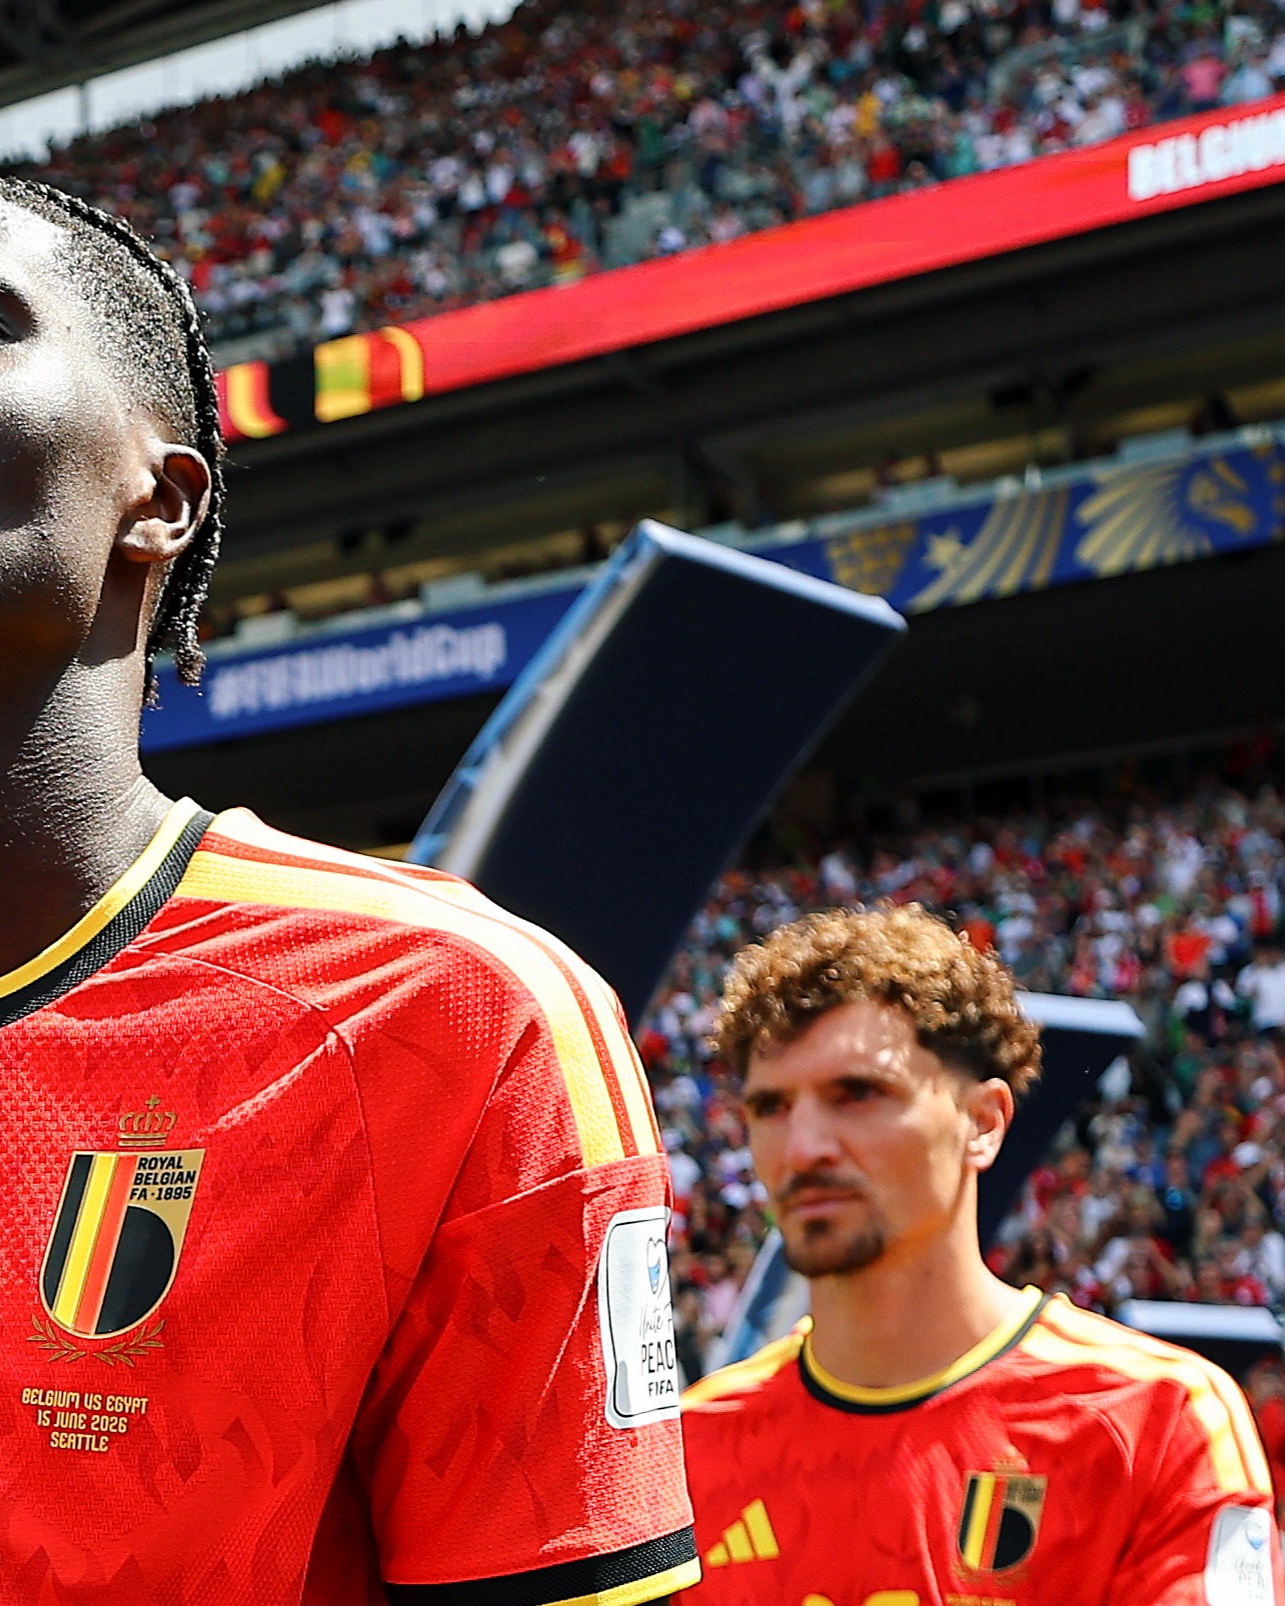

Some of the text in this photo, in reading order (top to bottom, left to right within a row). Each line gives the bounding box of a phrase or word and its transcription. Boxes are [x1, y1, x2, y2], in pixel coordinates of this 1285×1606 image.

[137, 1156, 183, 1170] ROYAL
[133, 1170, 197, 1186] BELGIAN
[129, 1187, 147, 1200] FA
[641, 1339, 674, 1376] PEAC
[648, 1379, 674, 1397] FIFA
[21, 1387, 80, 1409] BELGIUM
[106, 1395, 149, 1414] EGYPT
[37, 1409, 128, 1433] 15 JUNE 2026
[50, 1431, 109, 1452] SEATTLE
